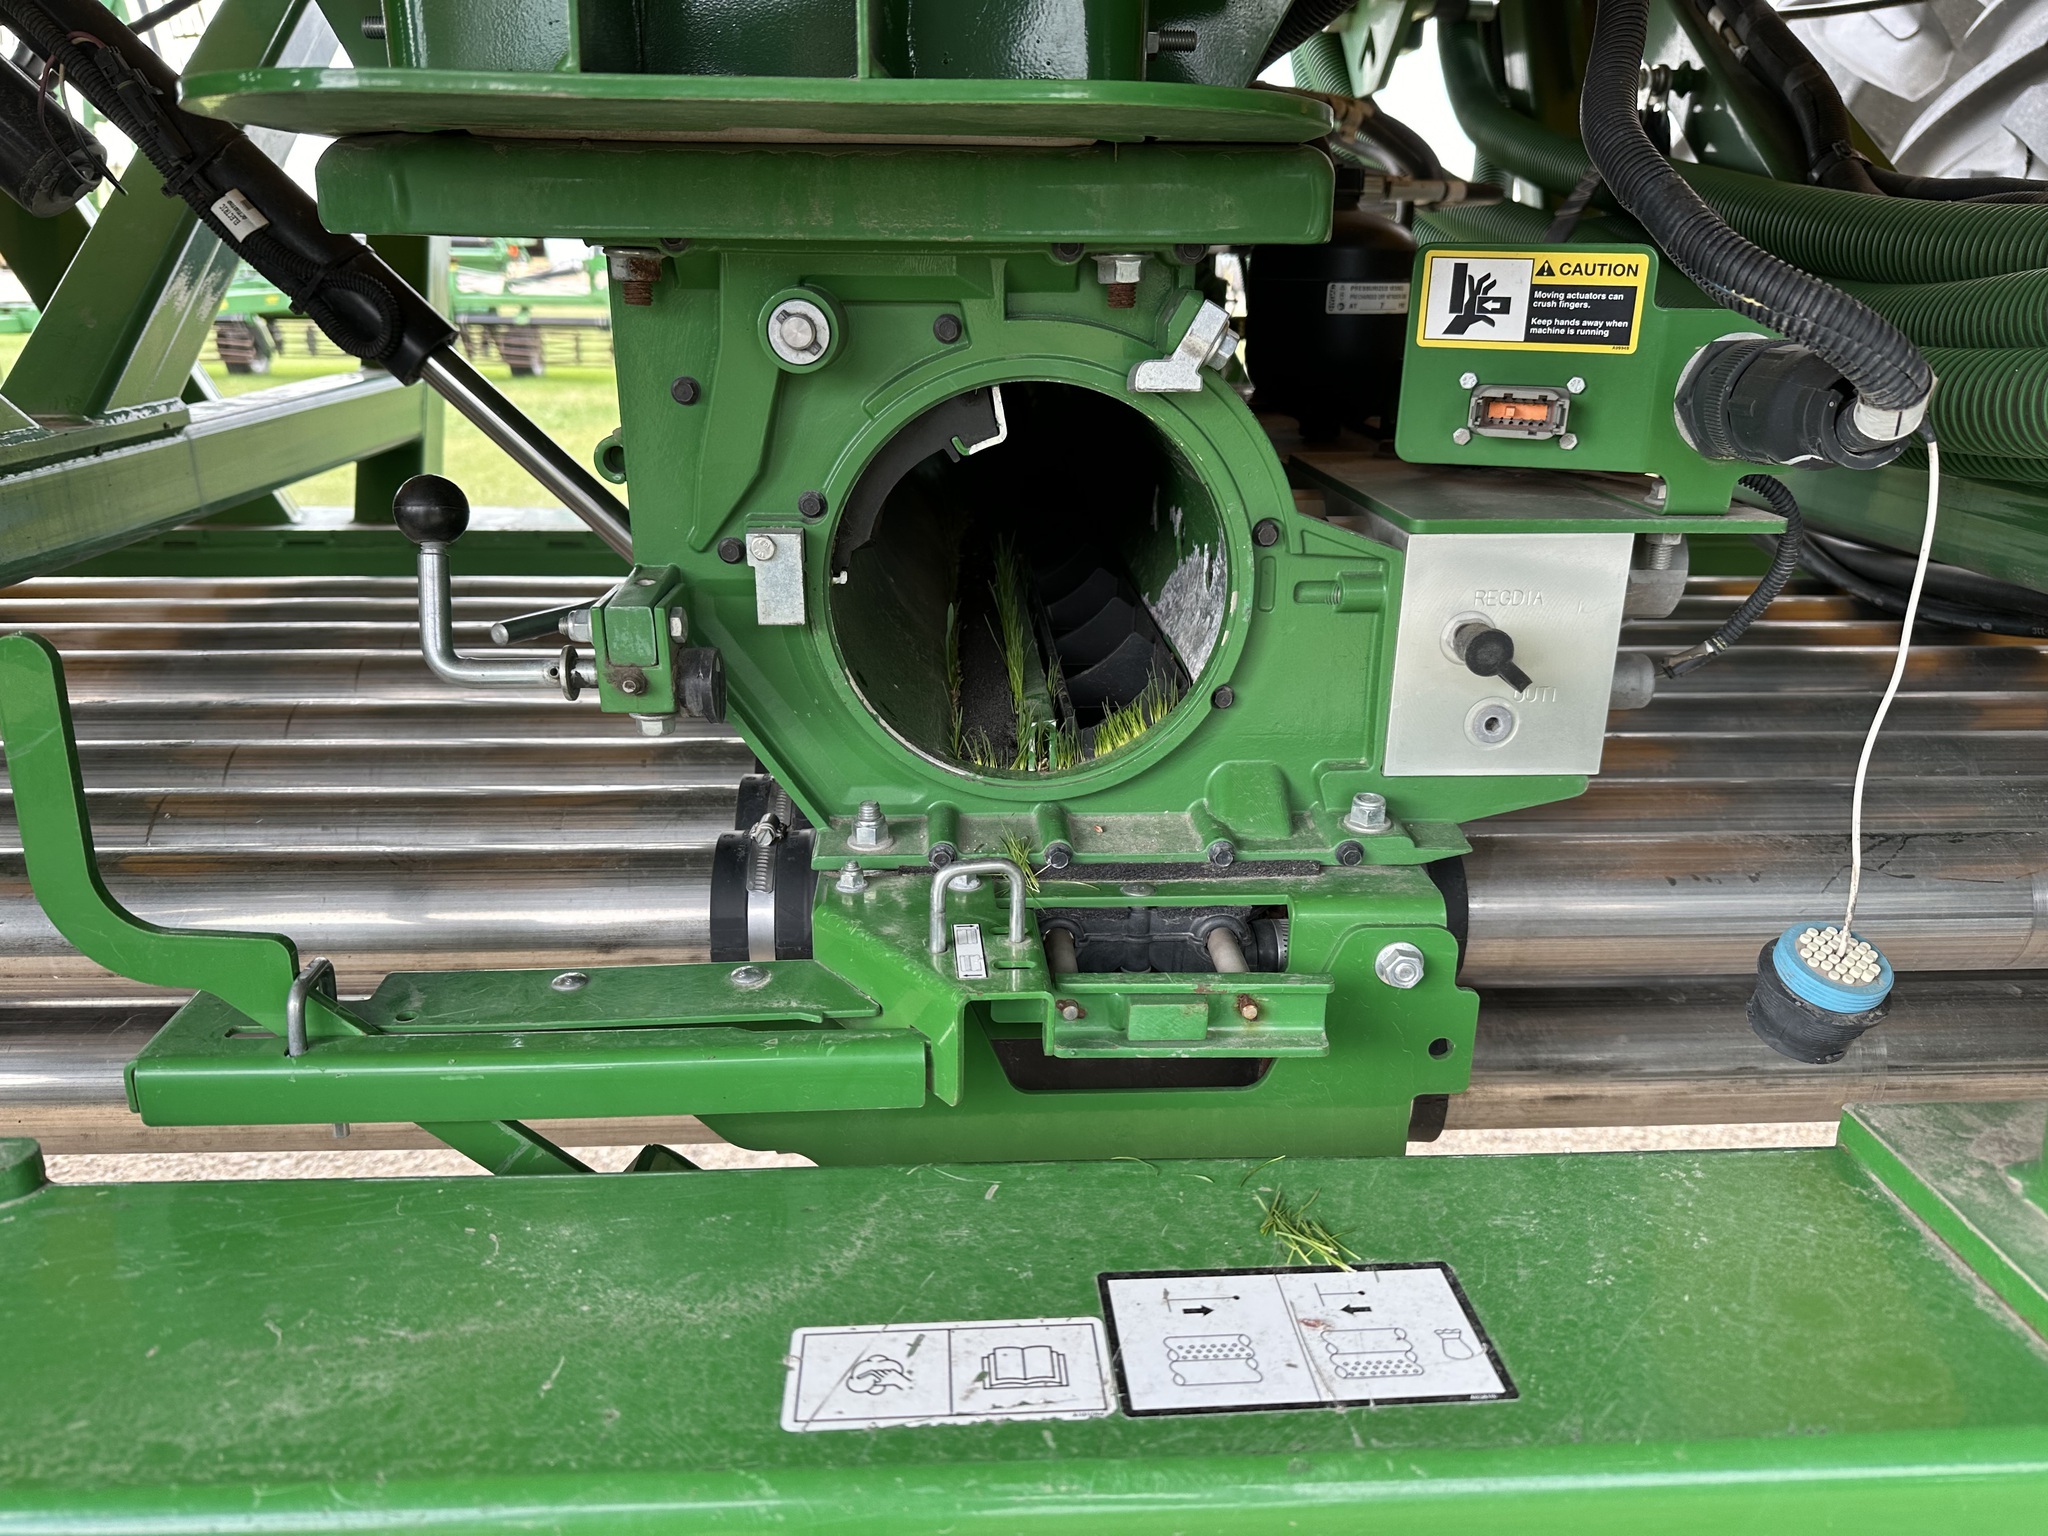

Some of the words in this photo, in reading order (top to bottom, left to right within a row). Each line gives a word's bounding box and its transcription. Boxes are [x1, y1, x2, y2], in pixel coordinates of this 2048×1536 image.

[219, 204, 241, 226] ELECTRIC
[1559, 263, 1639, 277] CAUTION
[1534, 291, 1564, 300] Moving
[1566, 292, 1606, 300] actuators
[1533, 300, 1556, 308] crush
[1558, 301, 1591, 310] fingers.
[1531, 318, 1552, 327] Keep
[1554, 318, 1580, 326] hands
[1582, 320, 1604, 328] away
[1606, 320, 1628, 328] when
[1530, 327, 1565, 335] machine
[1567, 327, 1574, 335] is
[1576, 328, 1609, 337] running
[1474, 589, 1544, 606] REGDIA
